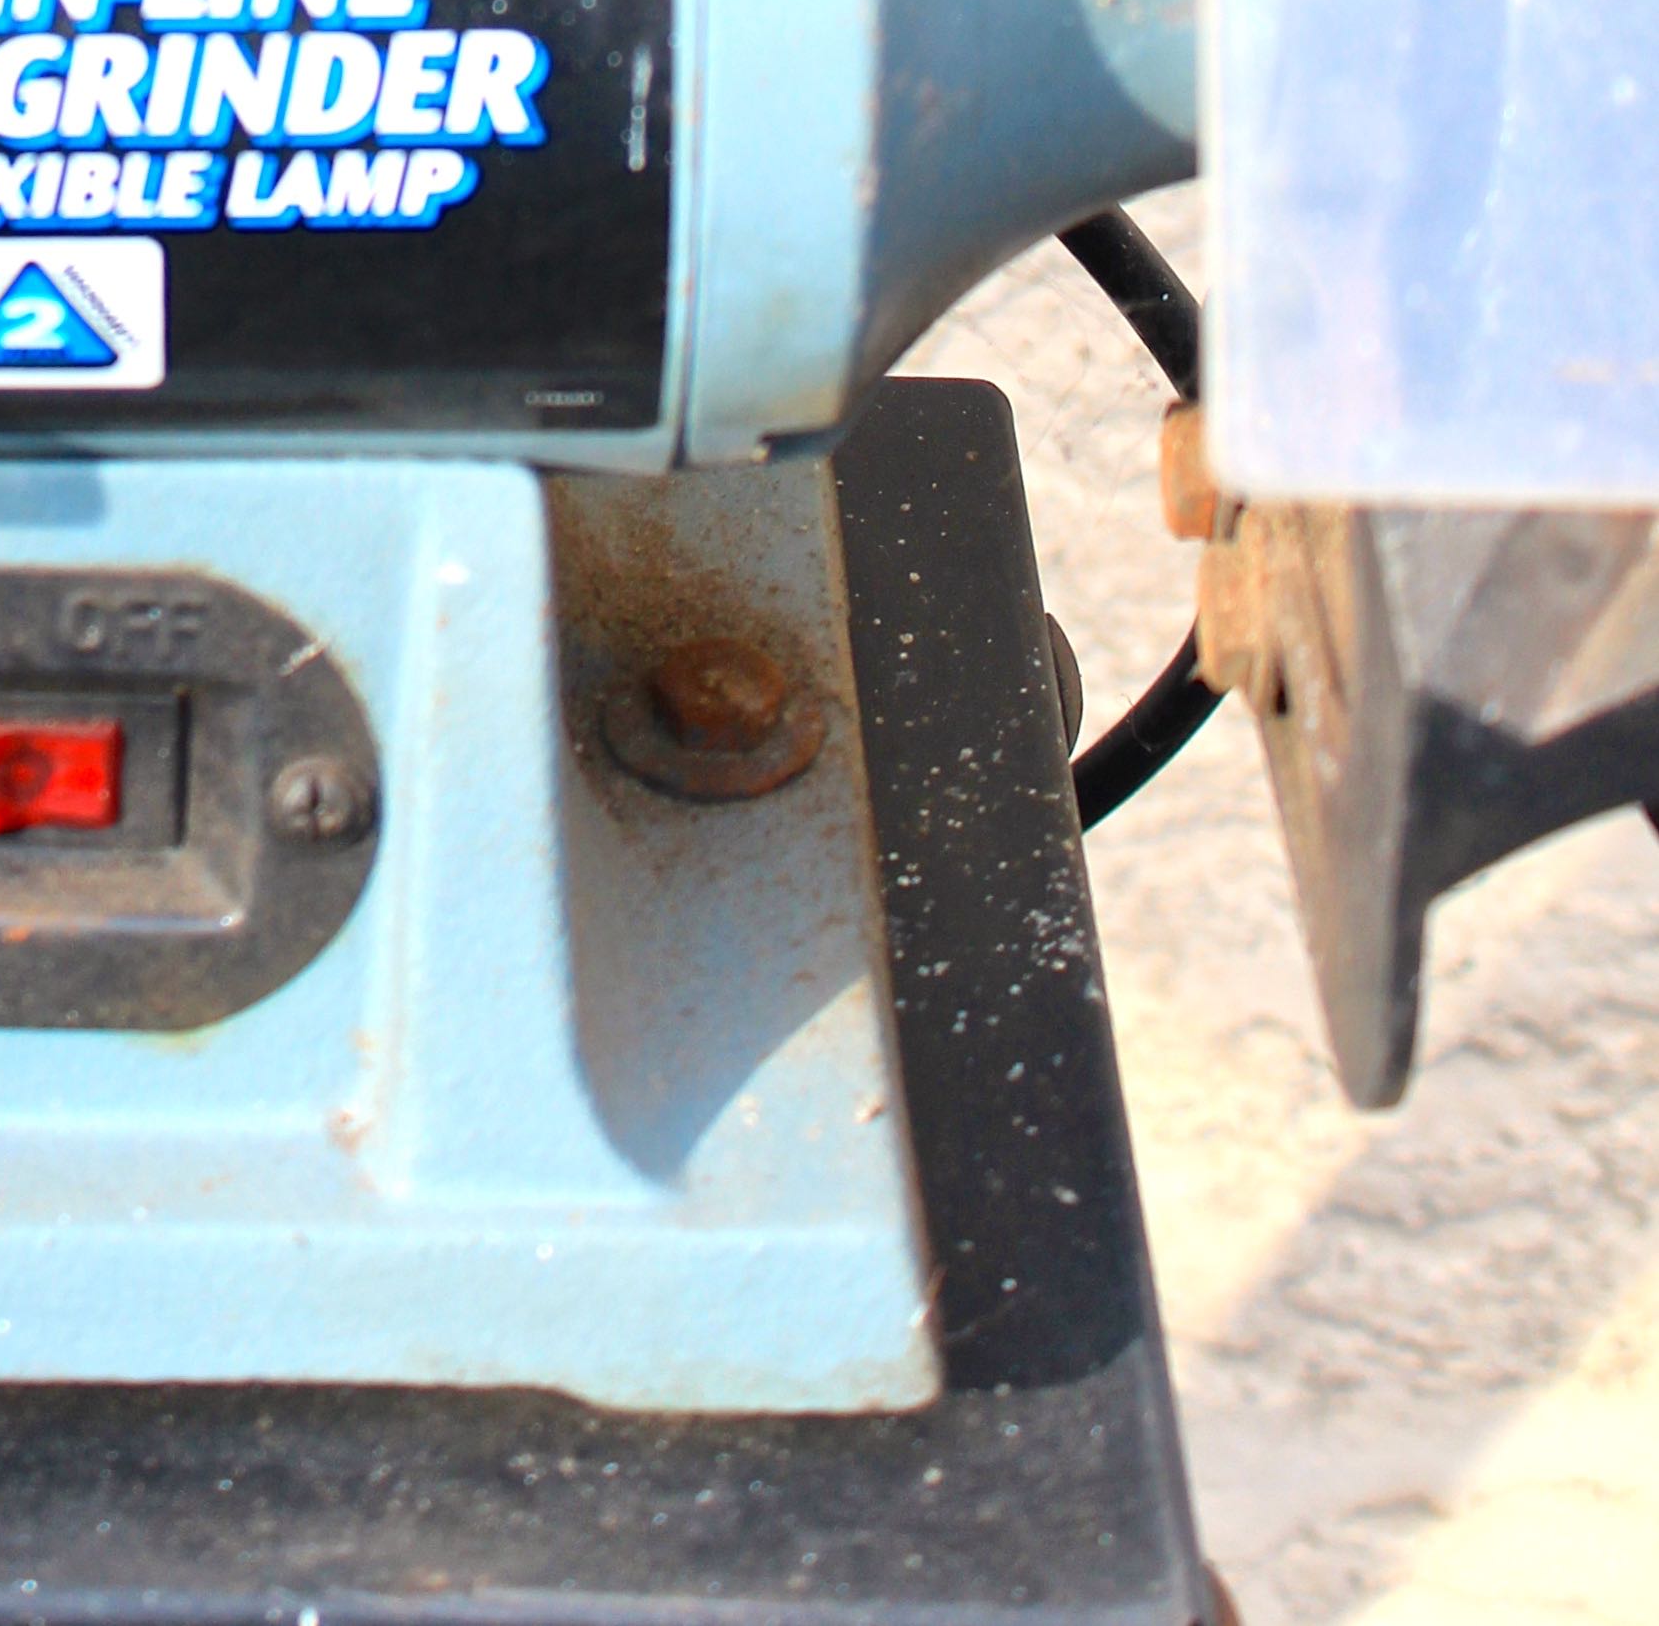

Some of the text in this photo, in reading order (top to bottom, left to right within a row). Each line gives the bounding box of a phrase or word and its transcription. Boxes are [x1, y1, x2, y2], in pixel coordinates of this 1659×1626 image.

[224, 150, 479, 227] LAMP
[0, 297, 67, 350] 2
[60, 585, 210, 649] OFF
